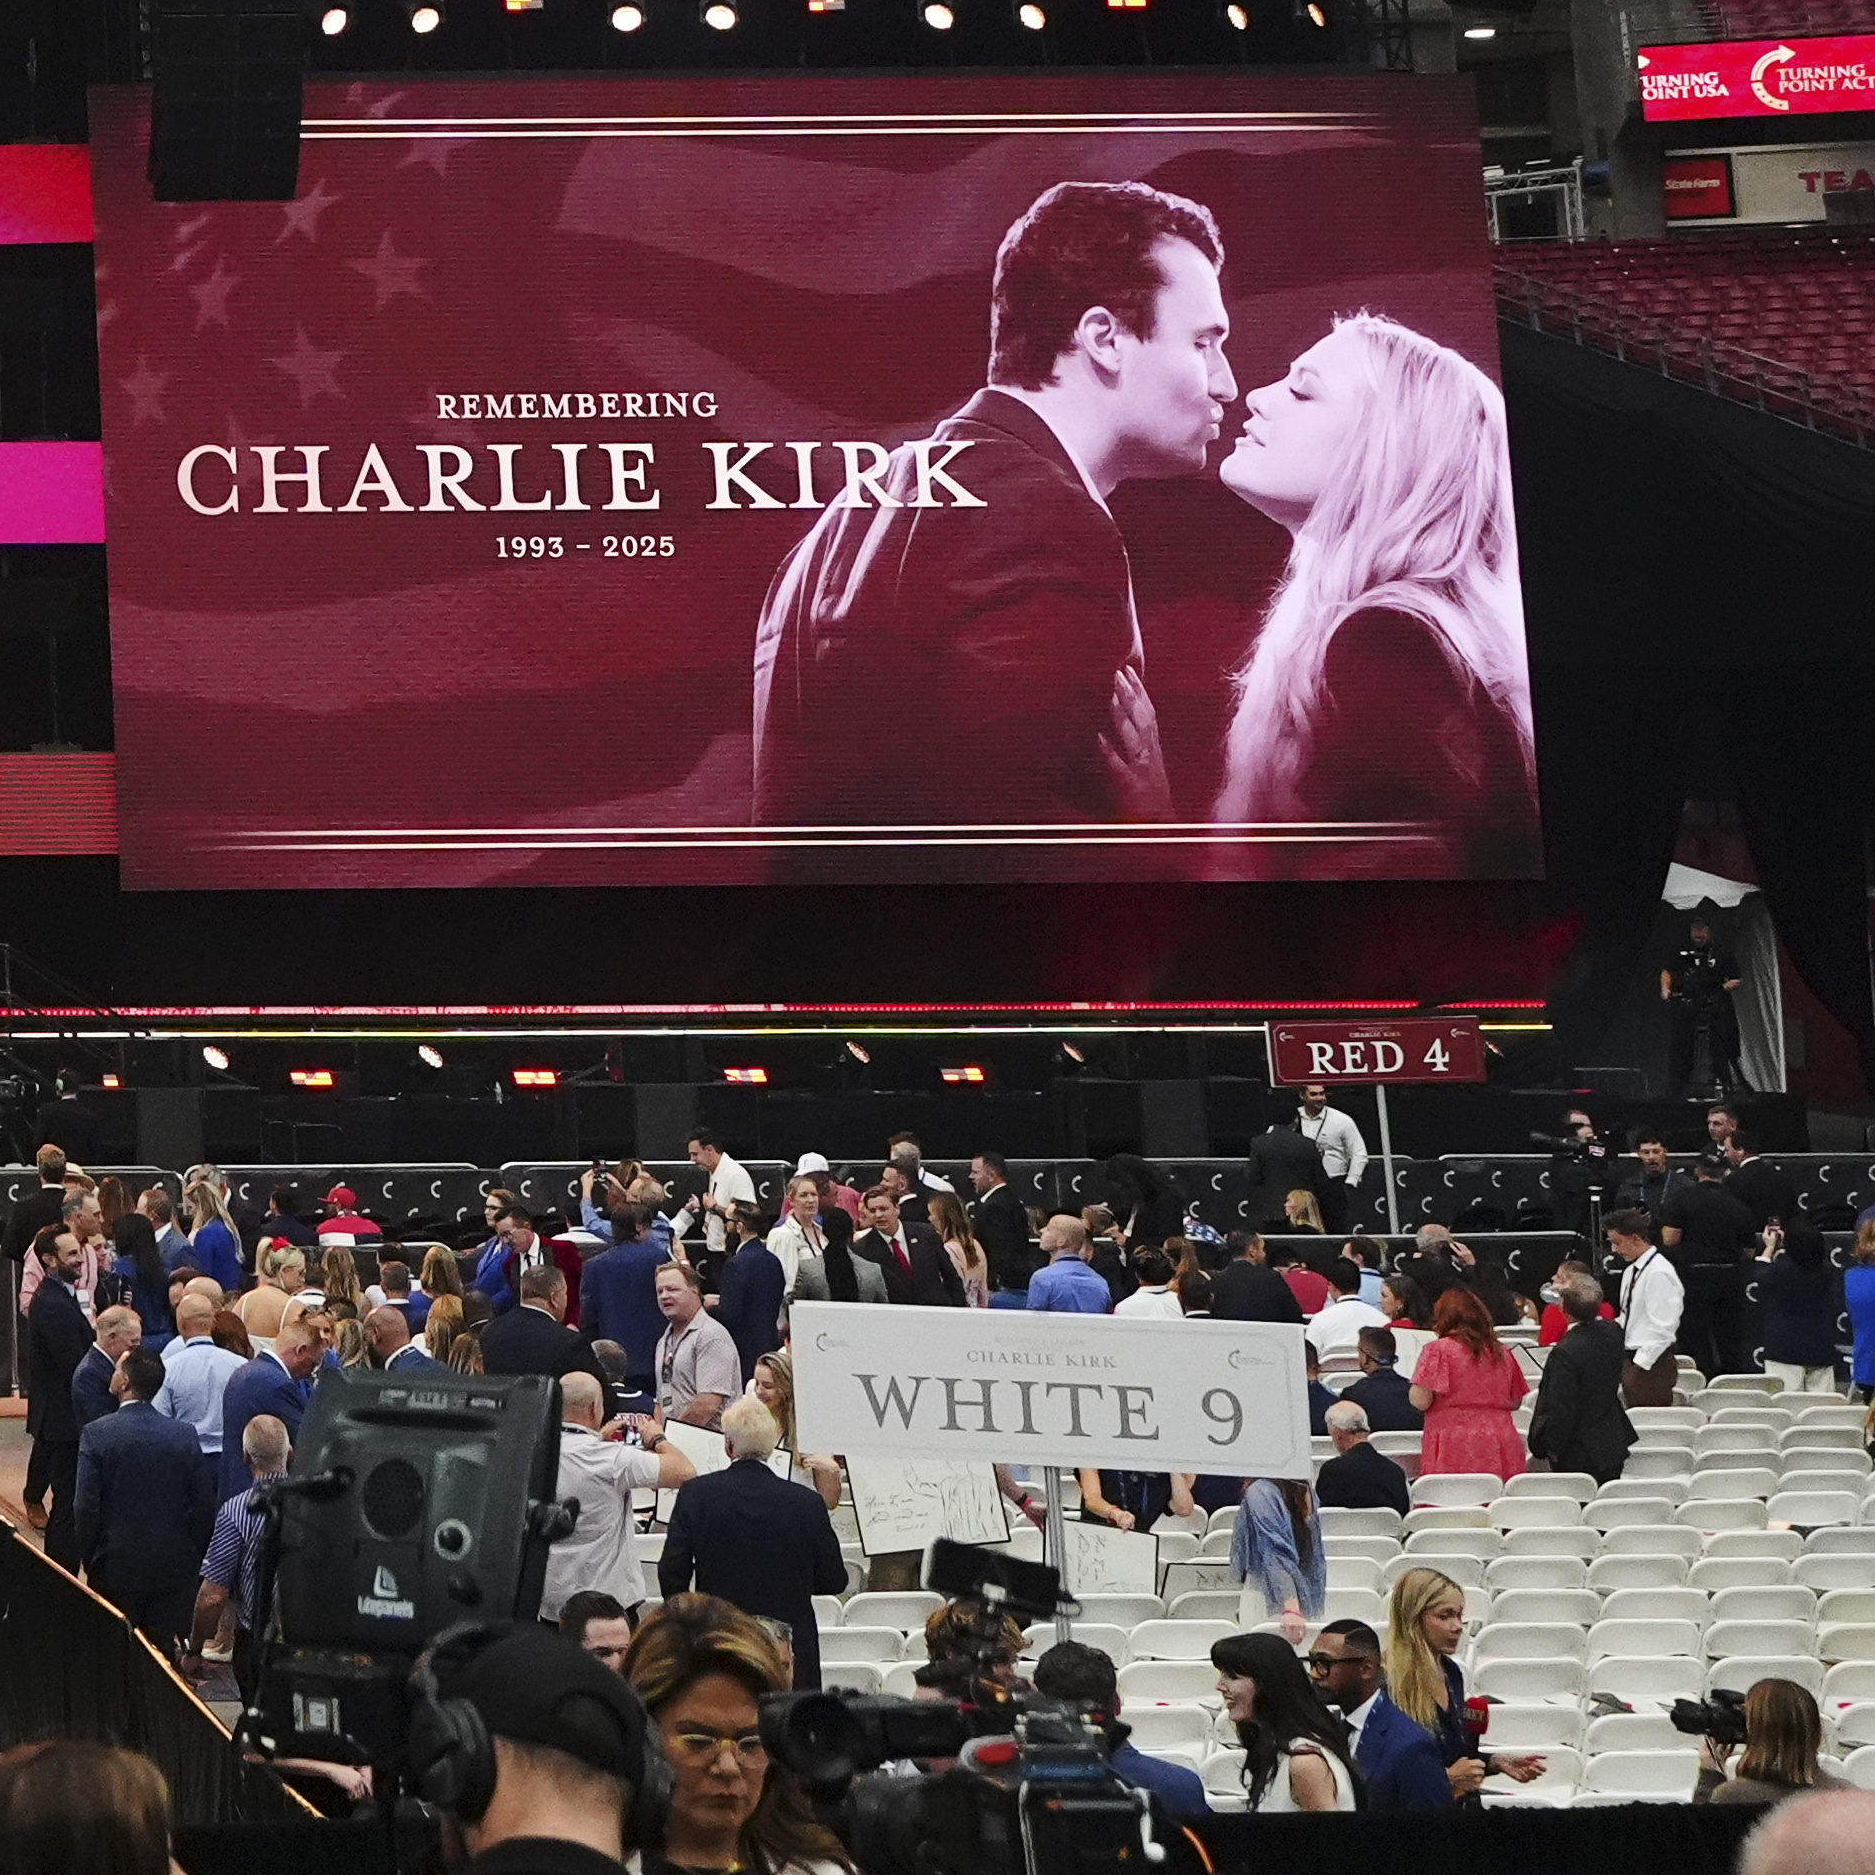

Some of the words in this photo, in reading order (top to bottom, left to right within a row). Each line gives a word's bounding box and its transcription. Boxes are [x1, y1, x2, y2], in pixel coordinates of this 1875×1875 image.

[1776, 64, 1866, 80] TURNING
[1642, 86, 1694, 101] OINT
[1694, 84, 1730, 98] USA
[1779, 79, 1837, 94] POINT
[1841, 76, 1875, 90] ACT
[1799, 168, 1875, 193] TEA
[437, 392, 719, 419] REMEMBERING
[176, 444, 660, 516] CHARLIE
[706, 441, 987, 509] KIRK
[496, 536, 564, 559] 1993
[603, 535, 676, 558] 2025
[1306, 1040, 1405, 1075] RED
[1423, 1038, 1450, 1072] 4
[966, 1349, 1055, 1367] CHARLIE
[1065, 1354, 1118, 1369] KIRK
[853, 1373, 1160, 1442] WHITE
[1202, 1387, 1244, 1447] 9
